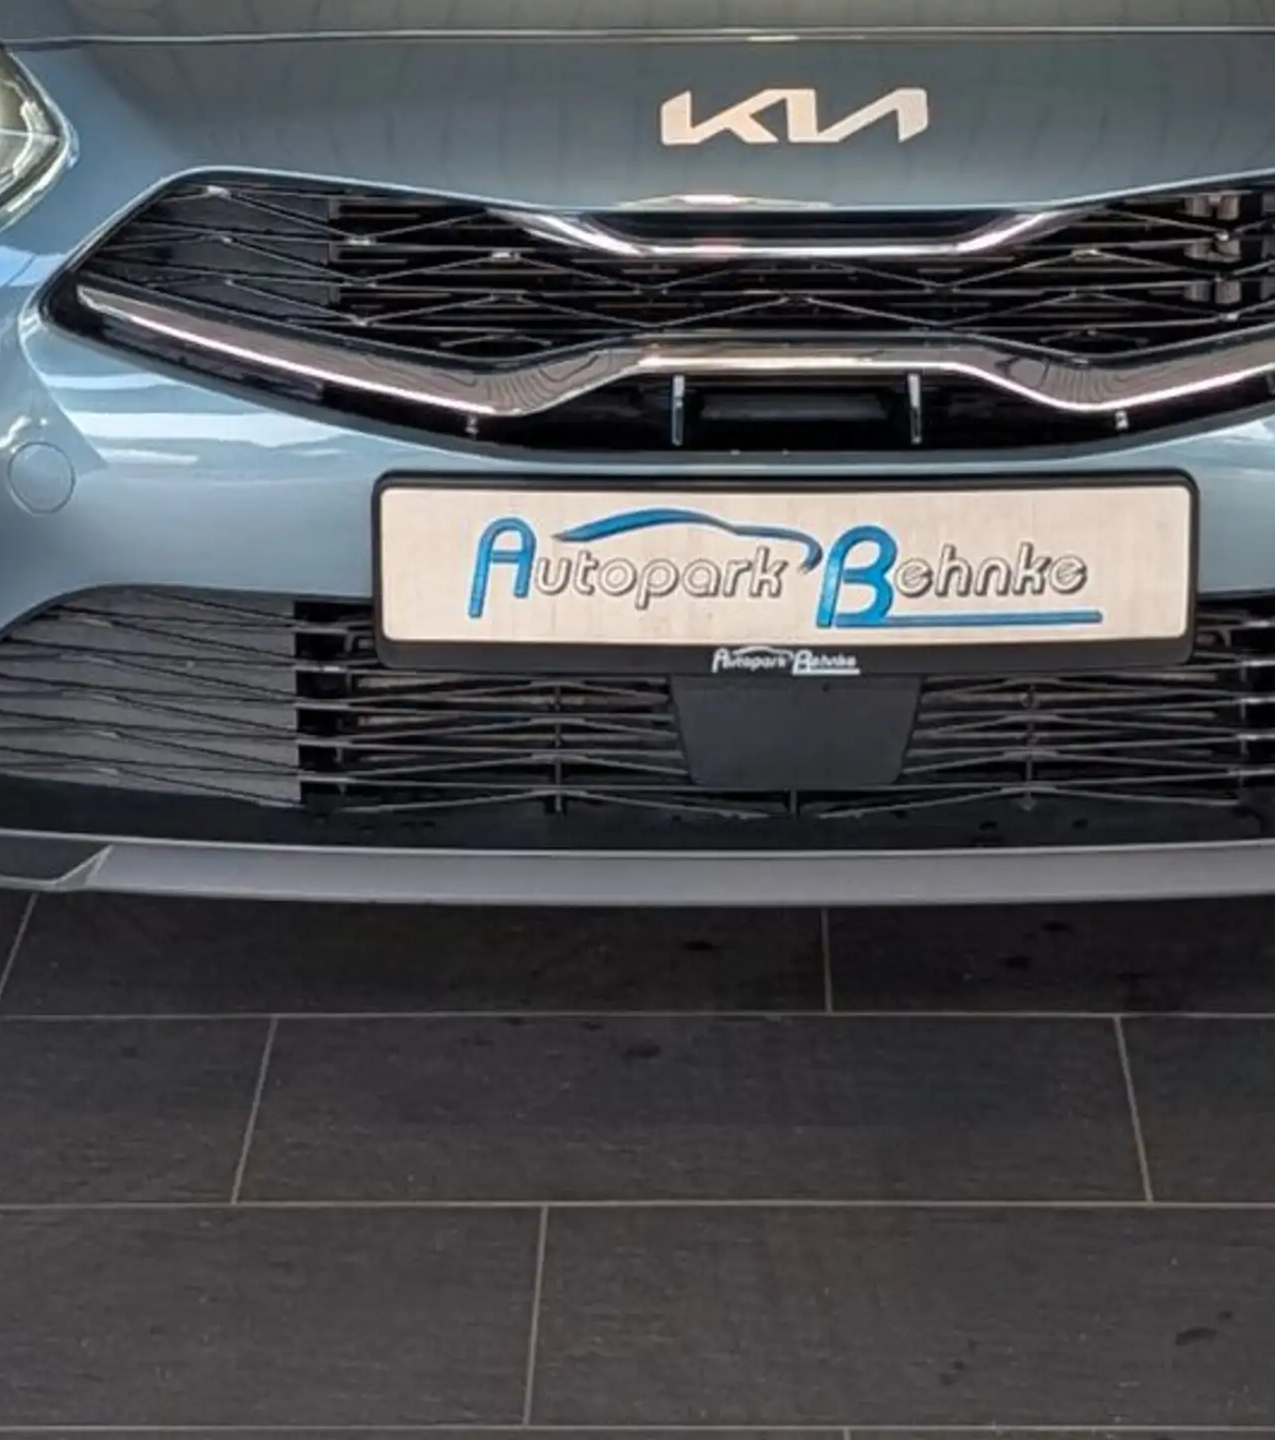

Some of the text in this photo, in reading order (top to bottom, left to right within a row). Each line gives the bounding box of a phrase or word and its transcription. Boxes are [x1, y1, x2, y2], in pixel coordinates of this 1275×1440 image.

[661, 88, 928, 145] KIA
[468, 516, 1088, 628] Autopark Behnke
